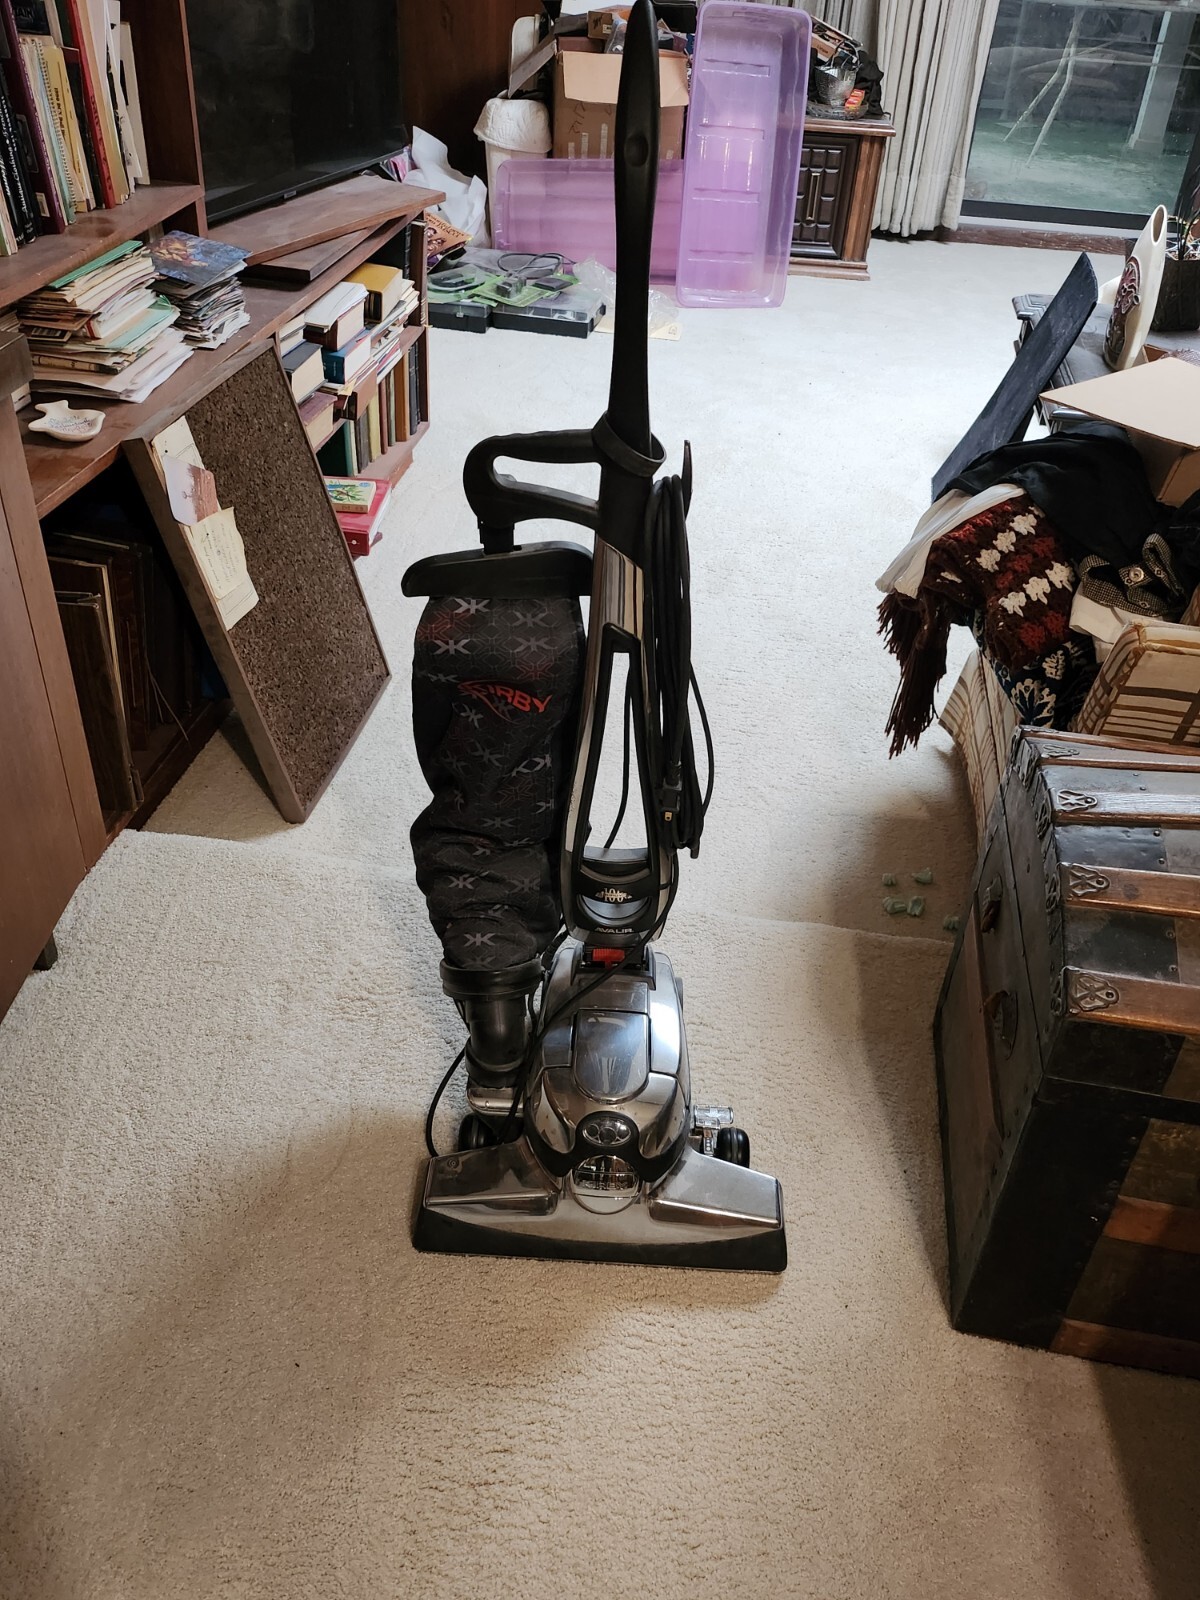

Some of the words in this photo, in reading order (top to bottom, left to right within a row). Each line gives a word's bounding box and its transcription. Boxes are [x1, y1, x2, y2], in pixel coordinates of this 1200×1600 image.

[8, 147, 19, 180] Clothing
[18, 180, 27, 213] Antique
[457, 680, 553, 714] KIRBY
